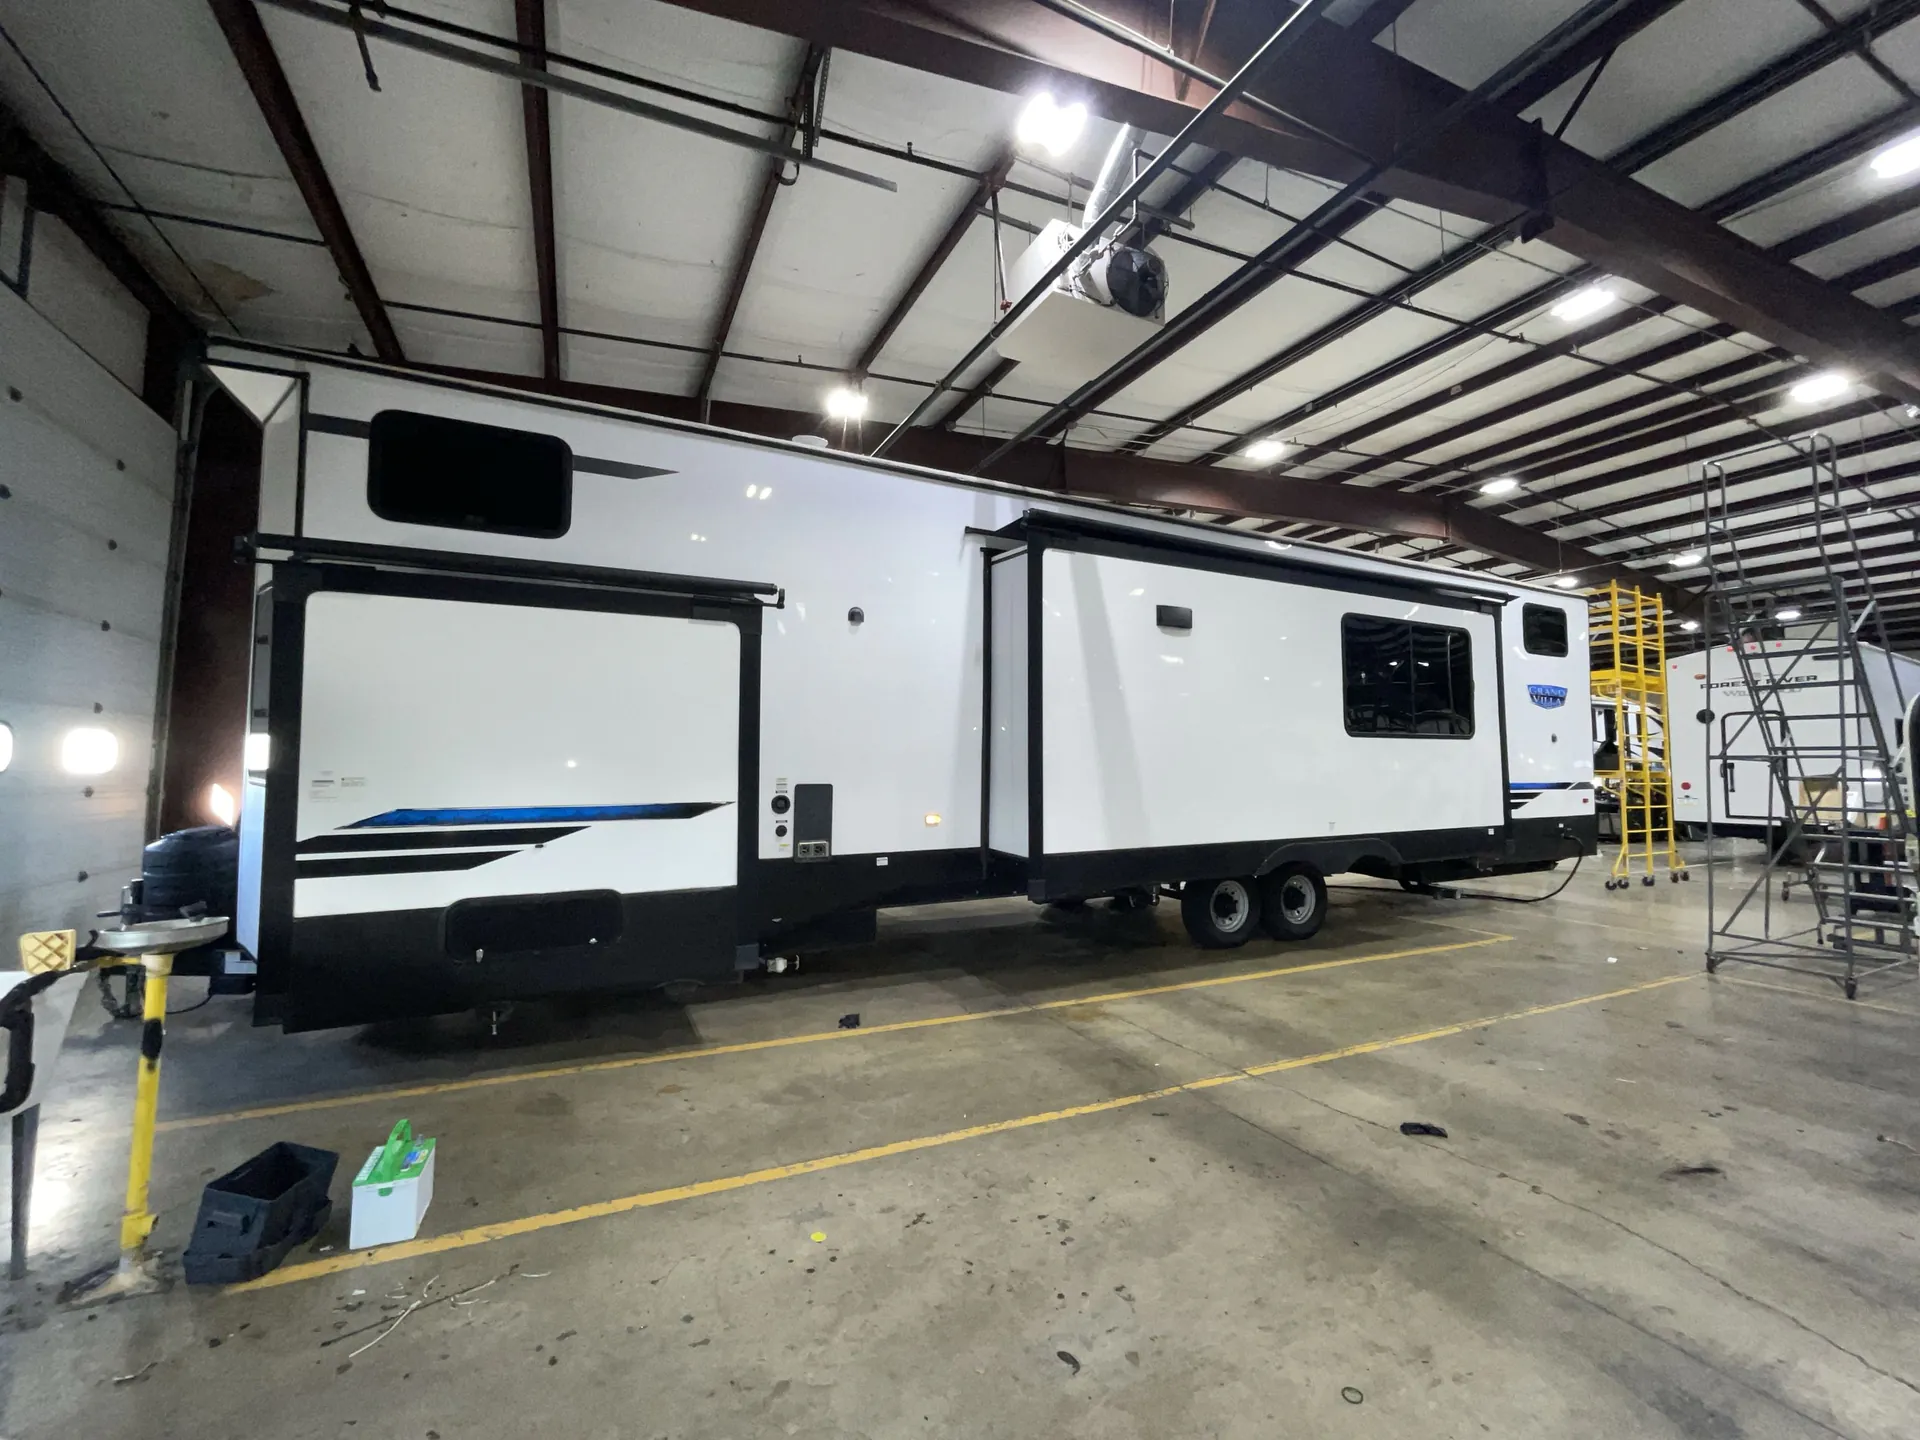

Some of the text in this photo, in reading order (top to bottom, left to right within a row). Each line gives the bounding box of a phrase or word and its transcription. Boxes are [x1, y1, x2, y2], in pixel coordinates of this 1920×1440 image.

[1766, 675, 1818, 684] RVER
[1530, 686, 1566, 697] GRAND
[1533, 695, 1562, 705] VILLA
